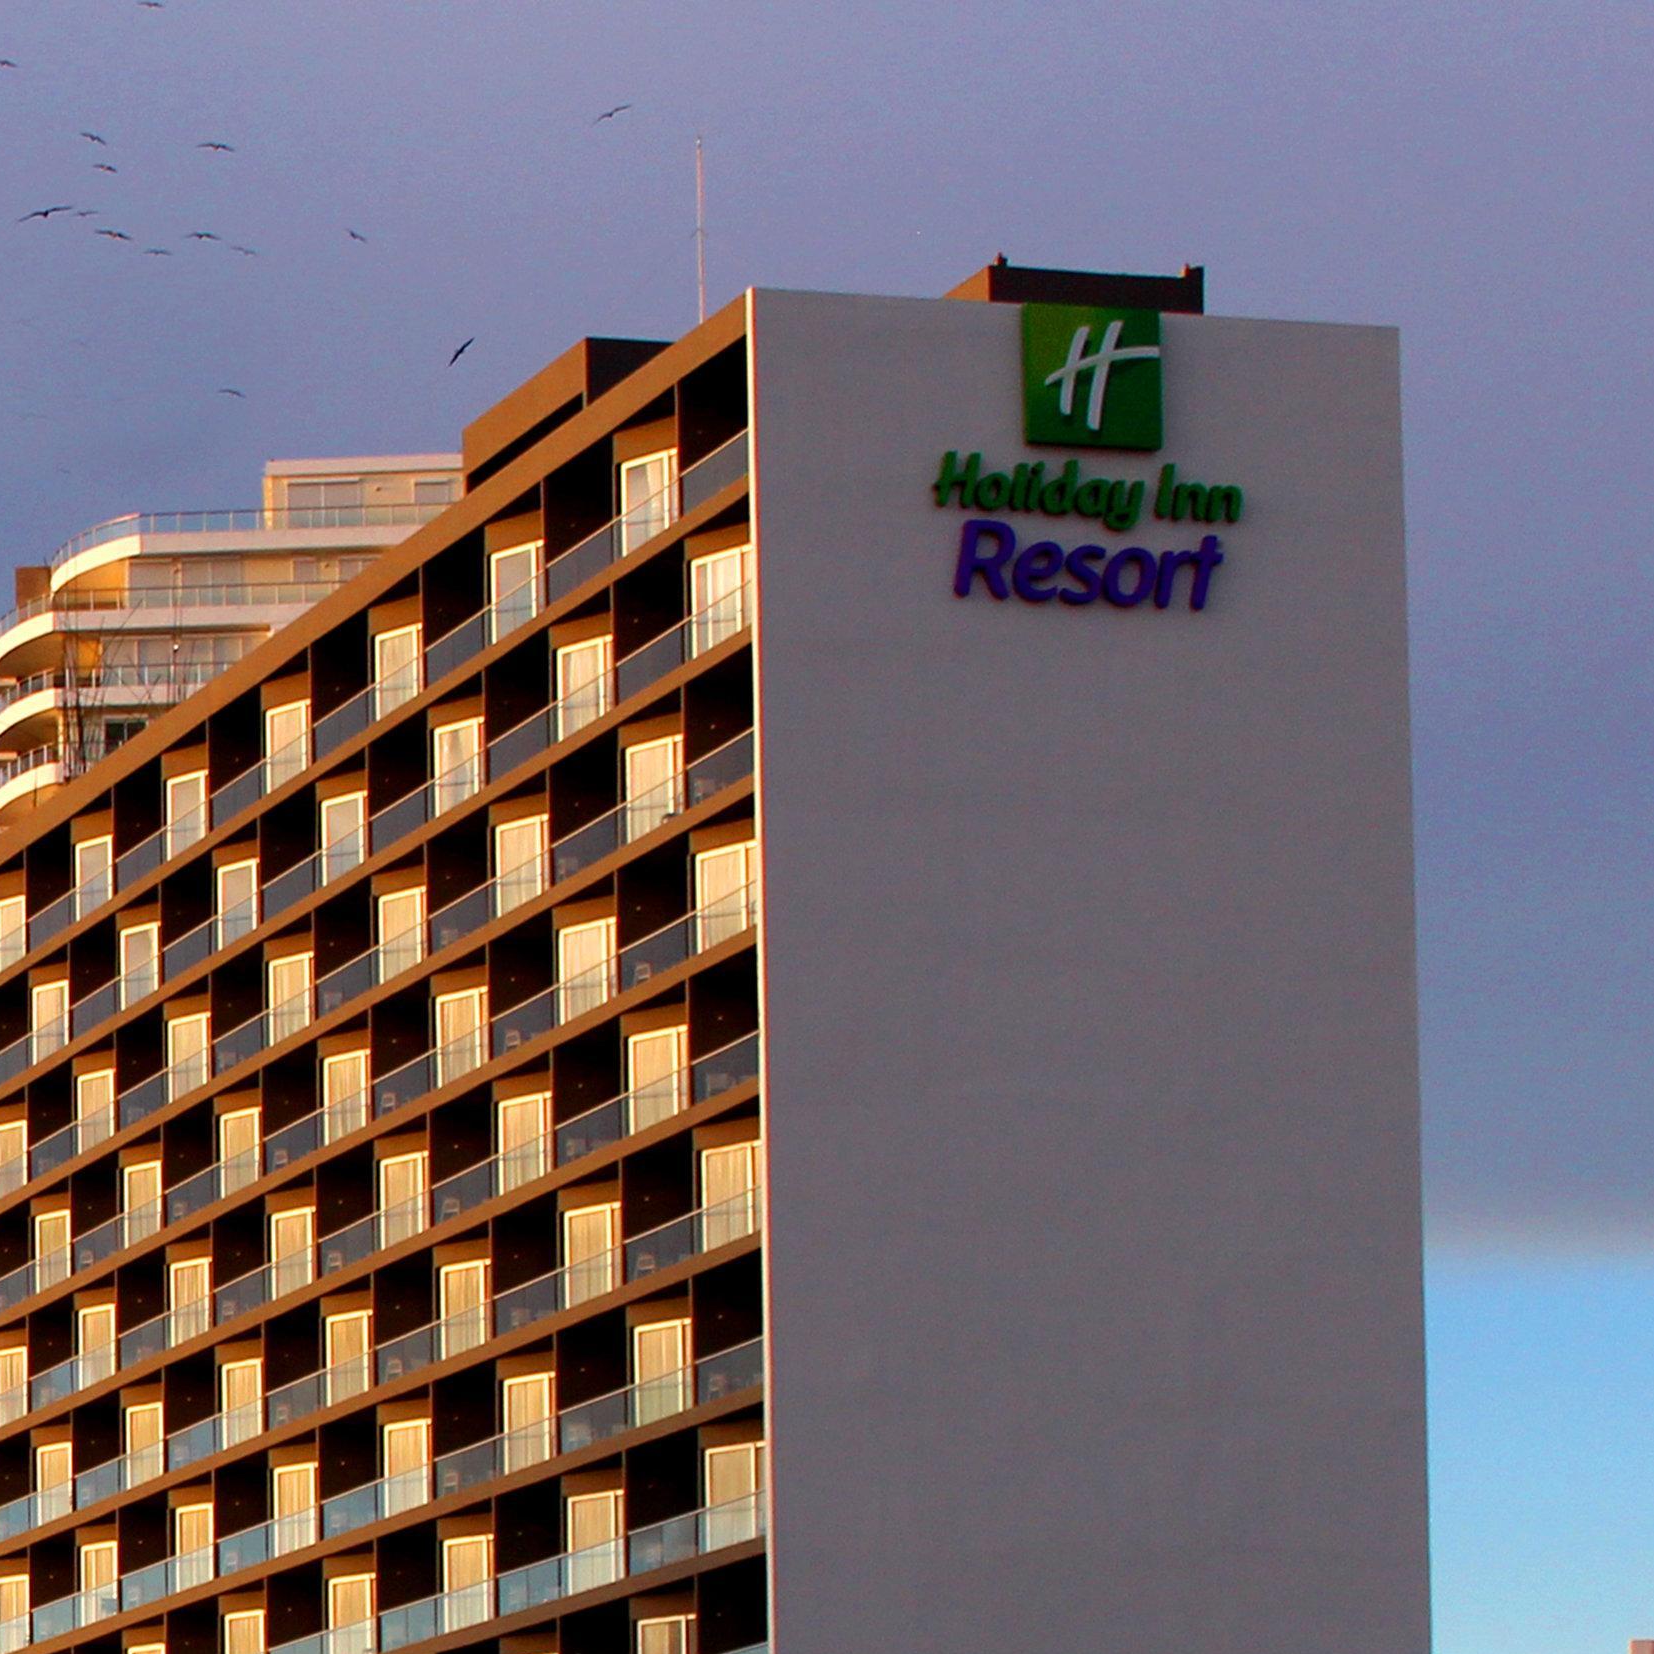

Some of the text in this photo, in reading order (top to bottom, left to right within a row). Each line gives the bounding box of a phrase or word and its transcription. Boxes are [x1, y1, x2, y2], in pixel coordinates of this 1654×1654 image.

[1045, 320, 1160, 431] H
[933, 450, 1244, 531] Holiday Inn
[954, 519, 1223, 610] Resort
